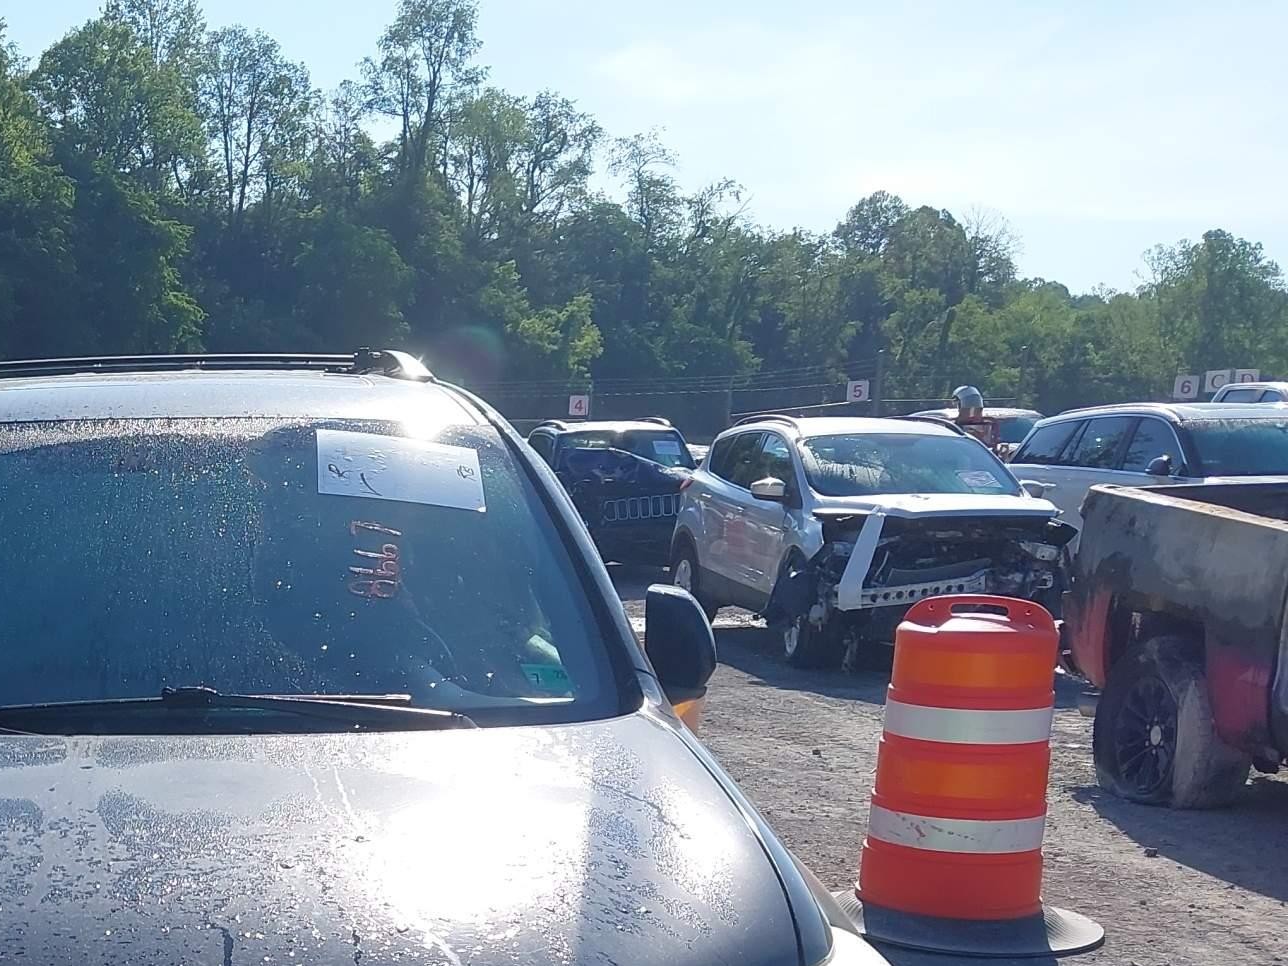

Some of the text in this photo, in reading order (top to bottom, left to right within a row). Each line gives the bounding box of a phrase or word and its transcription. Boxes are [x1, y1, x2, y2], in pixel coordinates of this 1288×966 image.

[852, 384, 863, 399] 5
[1180, 380, 1192, 394] 6
[574, 399, 584, 412] 4
[348, 519, 403, 598] 8667
